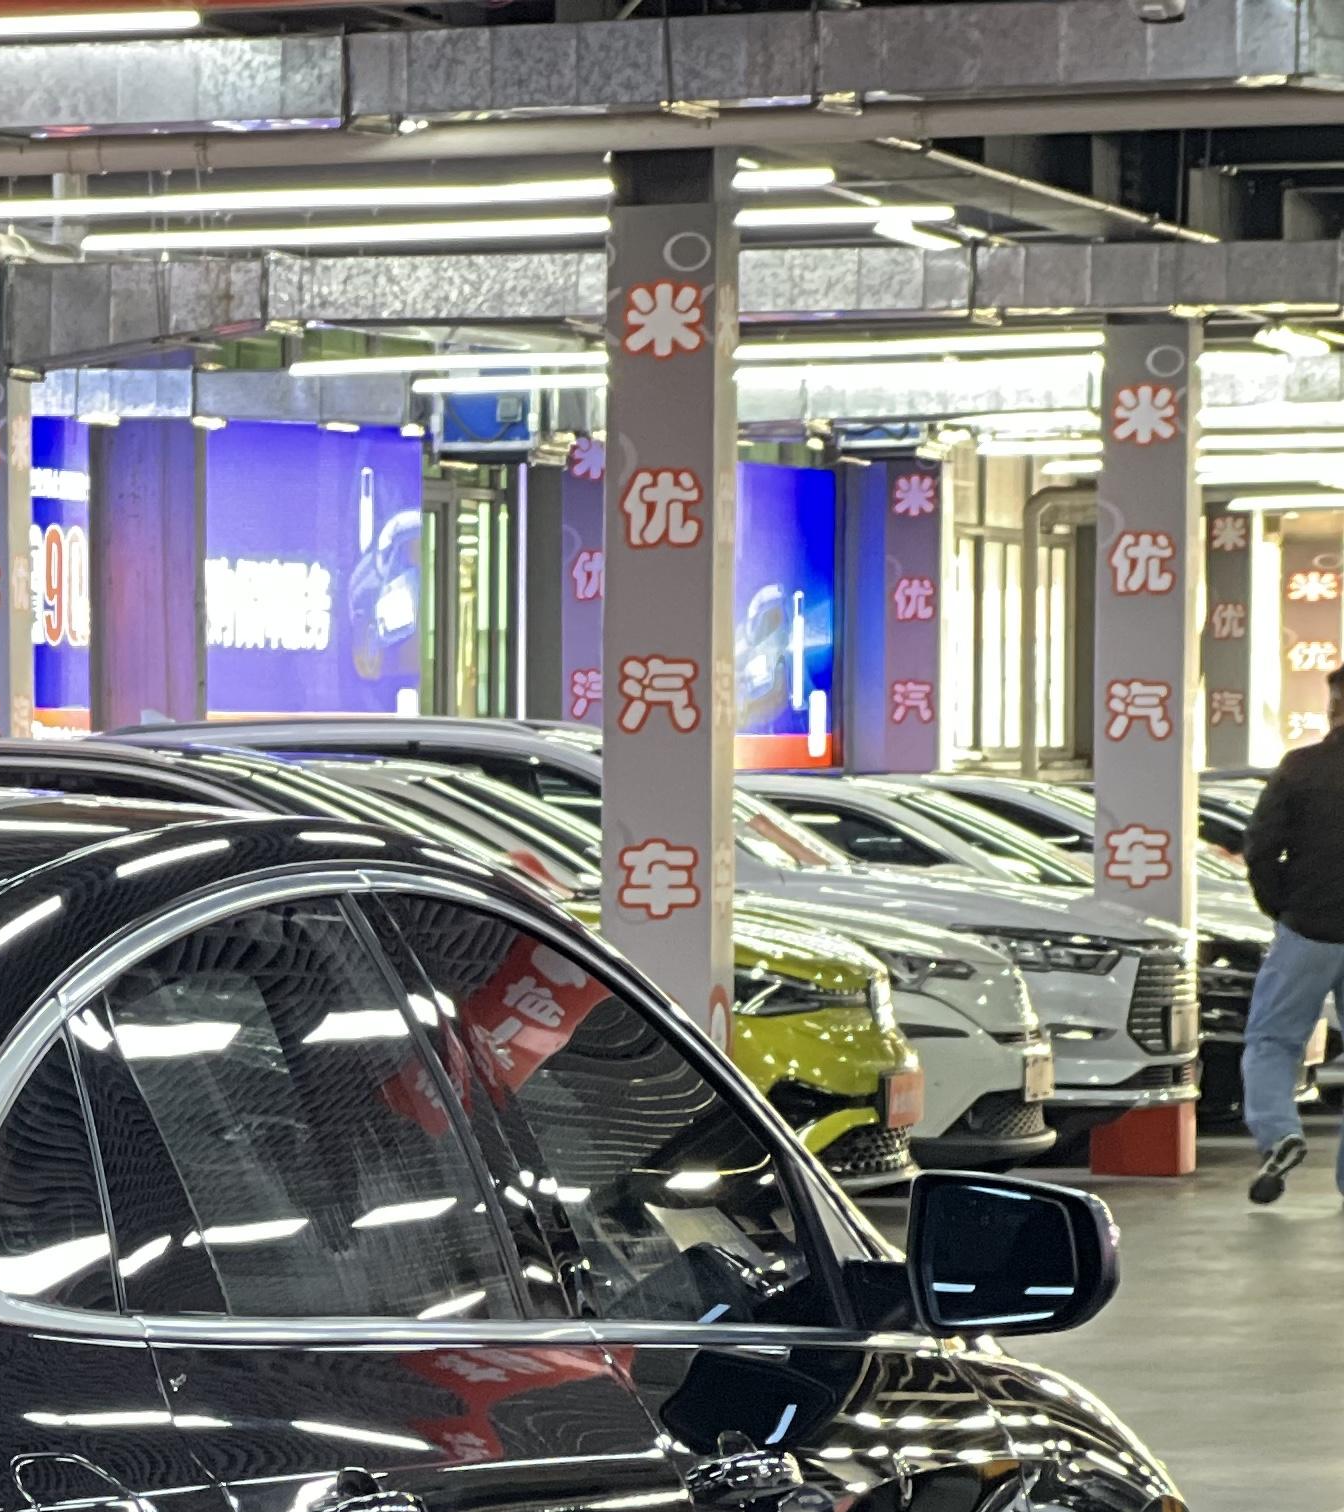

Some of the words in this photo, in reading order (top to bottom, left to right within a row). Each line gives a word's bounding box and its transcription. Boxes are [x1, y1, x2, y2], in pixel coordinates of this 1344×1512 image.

[618, 278, 706, 920] 米优汽车
[1105, 383, 1177, 889] 米优汽车
